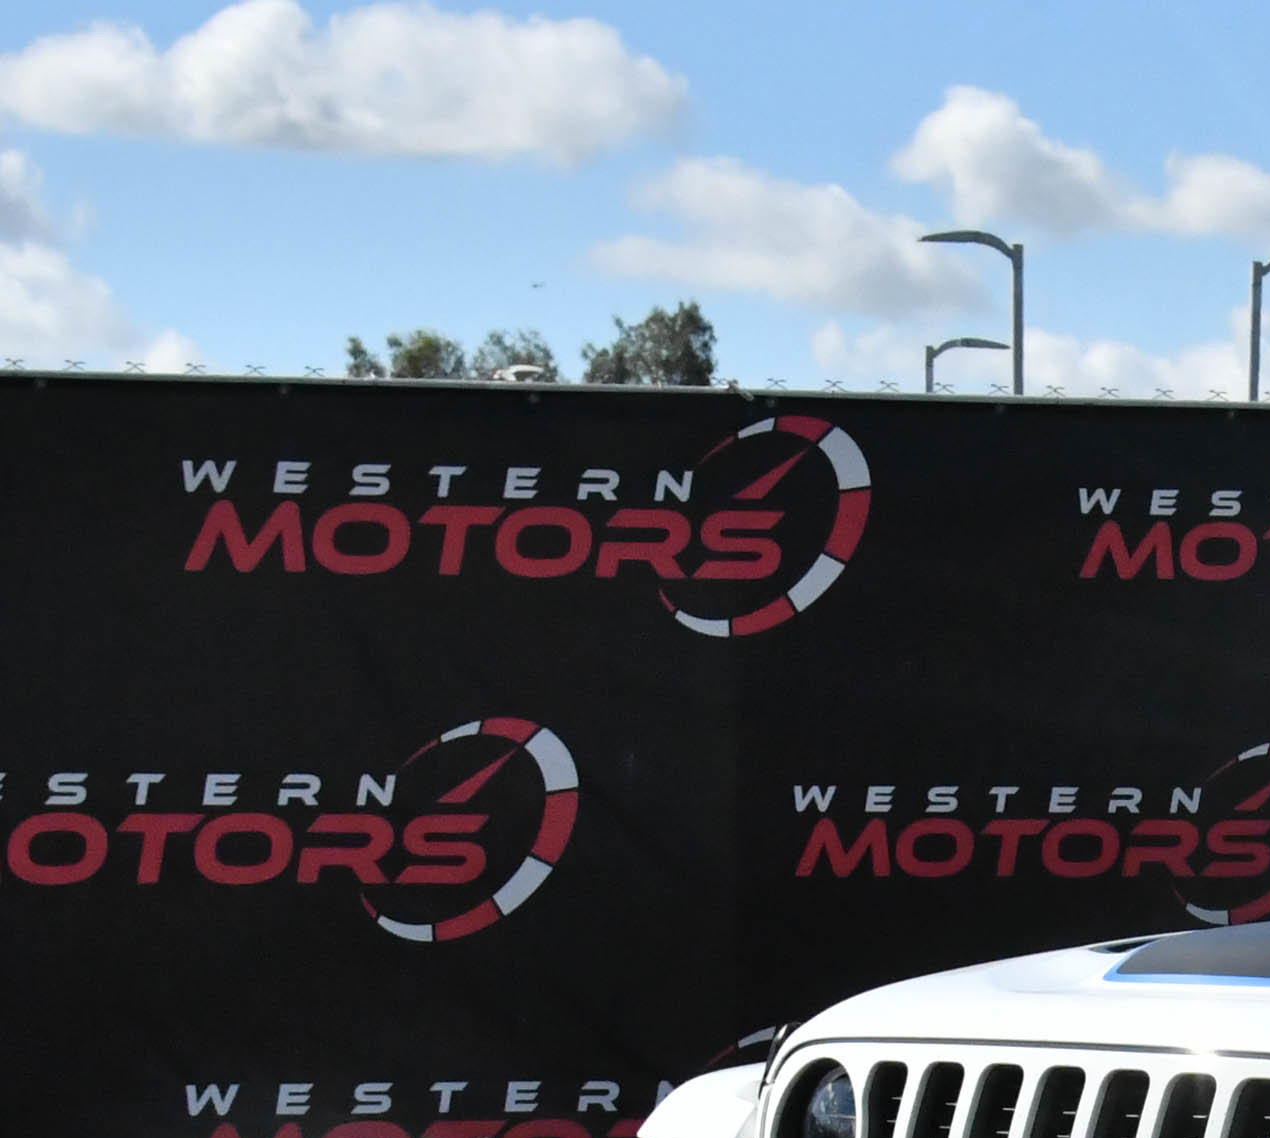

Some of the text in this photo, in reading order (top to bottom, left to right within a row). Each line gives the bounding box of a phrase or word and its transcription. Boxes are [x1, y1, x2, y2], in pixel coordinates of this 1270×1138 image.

[183, 460, 694, 502] WESTERN
[184, 499, 786, 579] MOTORS
[0, 772, 396, 807] STERN
[794, 785, 1202, 815] WESTERN
[0, 812, 488, 885] OTORS
